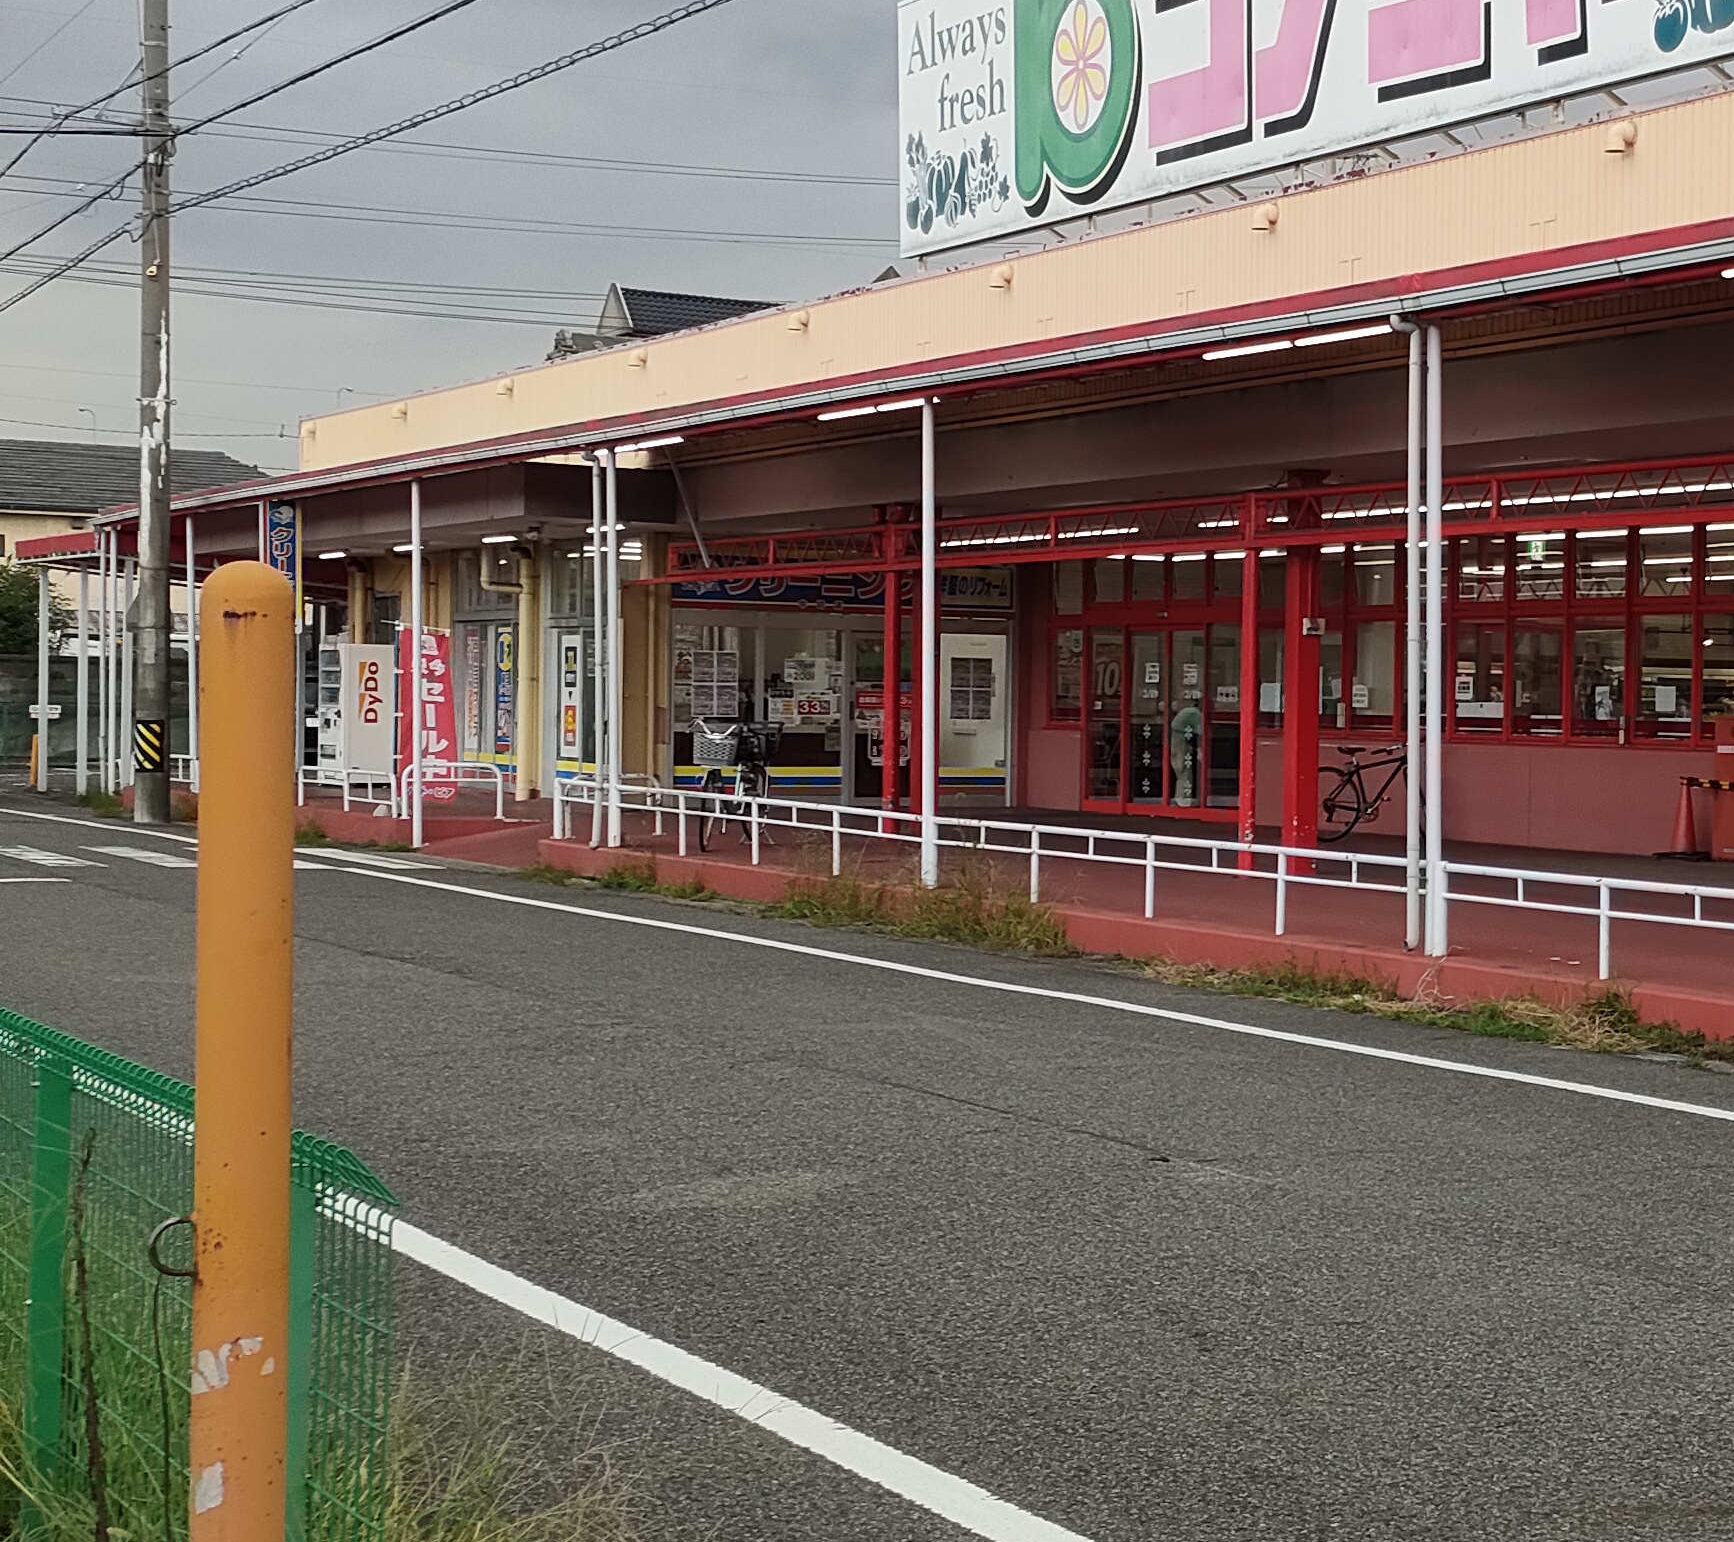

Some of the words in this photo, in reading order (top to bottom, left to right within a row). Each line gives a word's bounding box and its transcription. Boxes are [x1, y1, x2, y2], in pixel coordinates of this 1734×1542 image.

[906, 7, 1006, 76] Always
[938, 57, 1006, 133] fresh
[270, 526, 294, 588] クリー
[364, 661, 383, 723] DyDo
